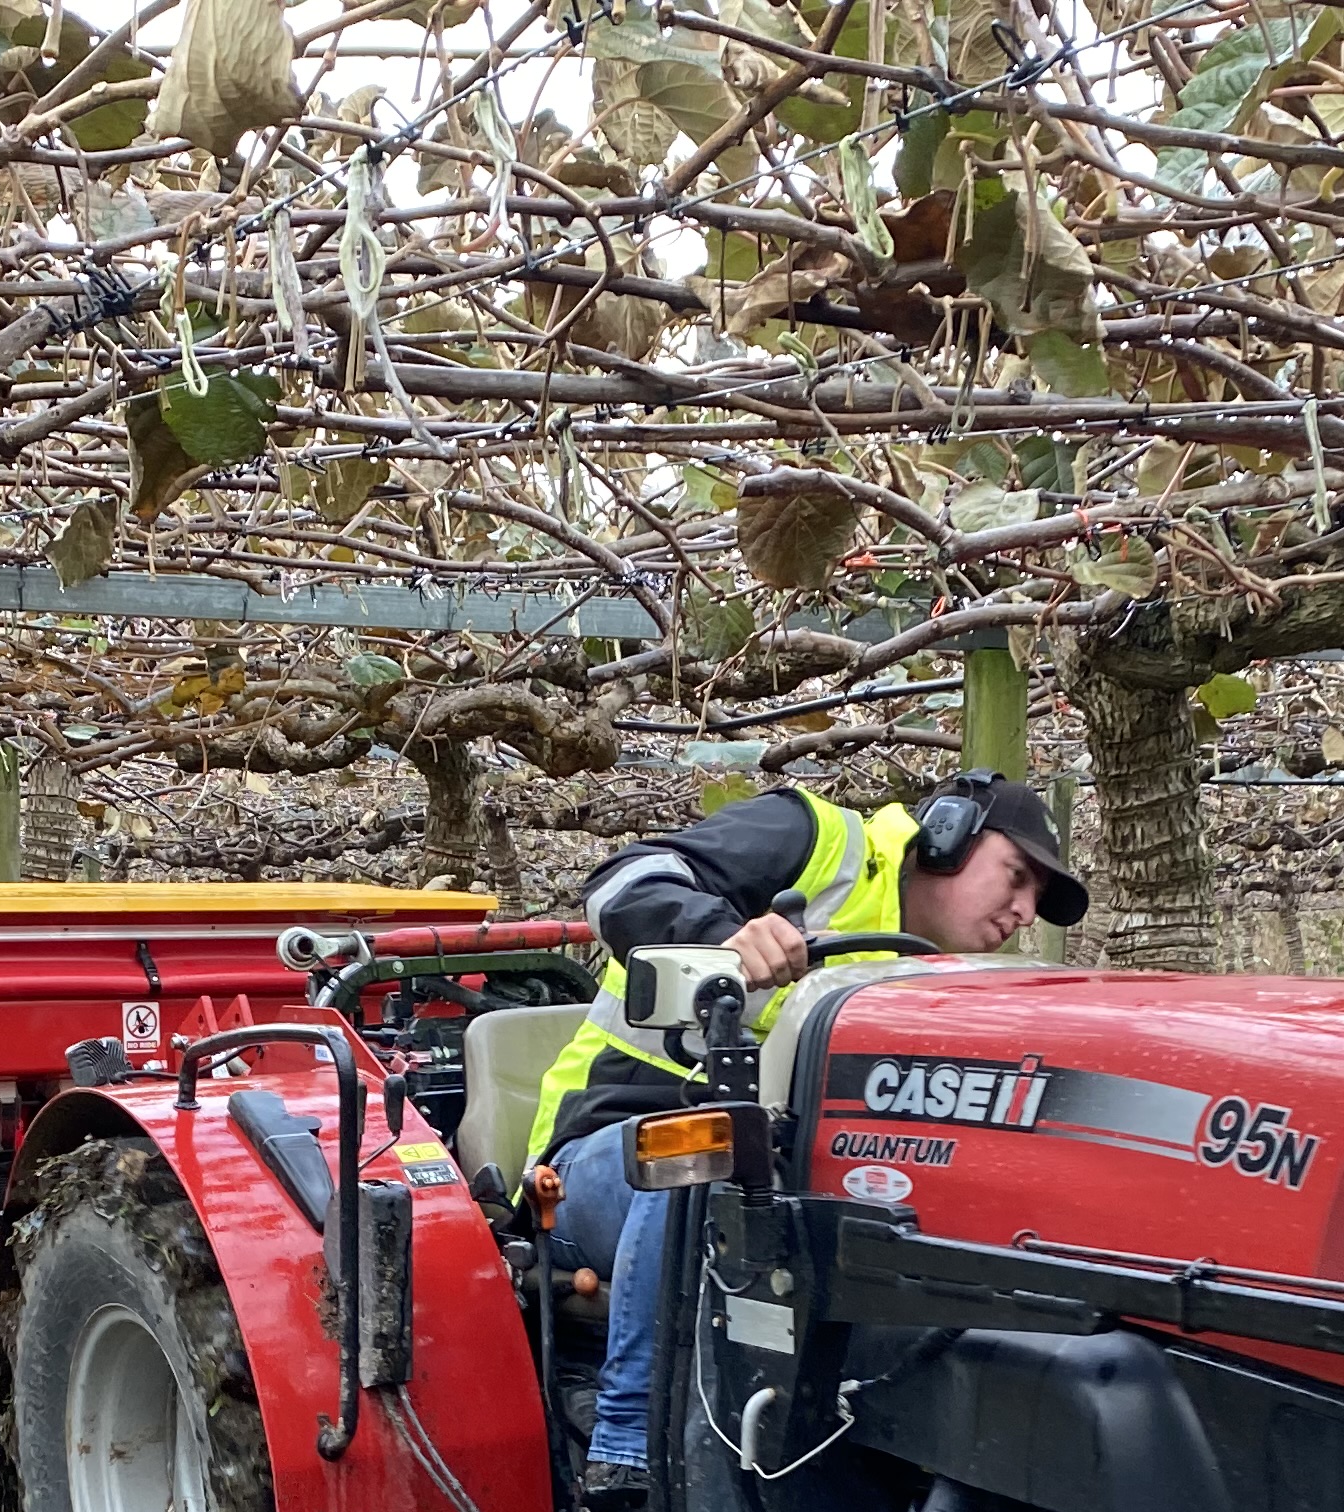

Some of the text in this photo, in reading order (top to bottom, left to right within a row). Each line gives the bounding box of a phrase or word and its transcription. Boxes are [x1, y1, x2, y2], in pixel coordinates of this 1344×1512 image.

[863, 1058, 998, 1122] CASE
[830, 1131, 957, 1166] QUANTUM
[1199, 1096, 1320, 1190] 95N
